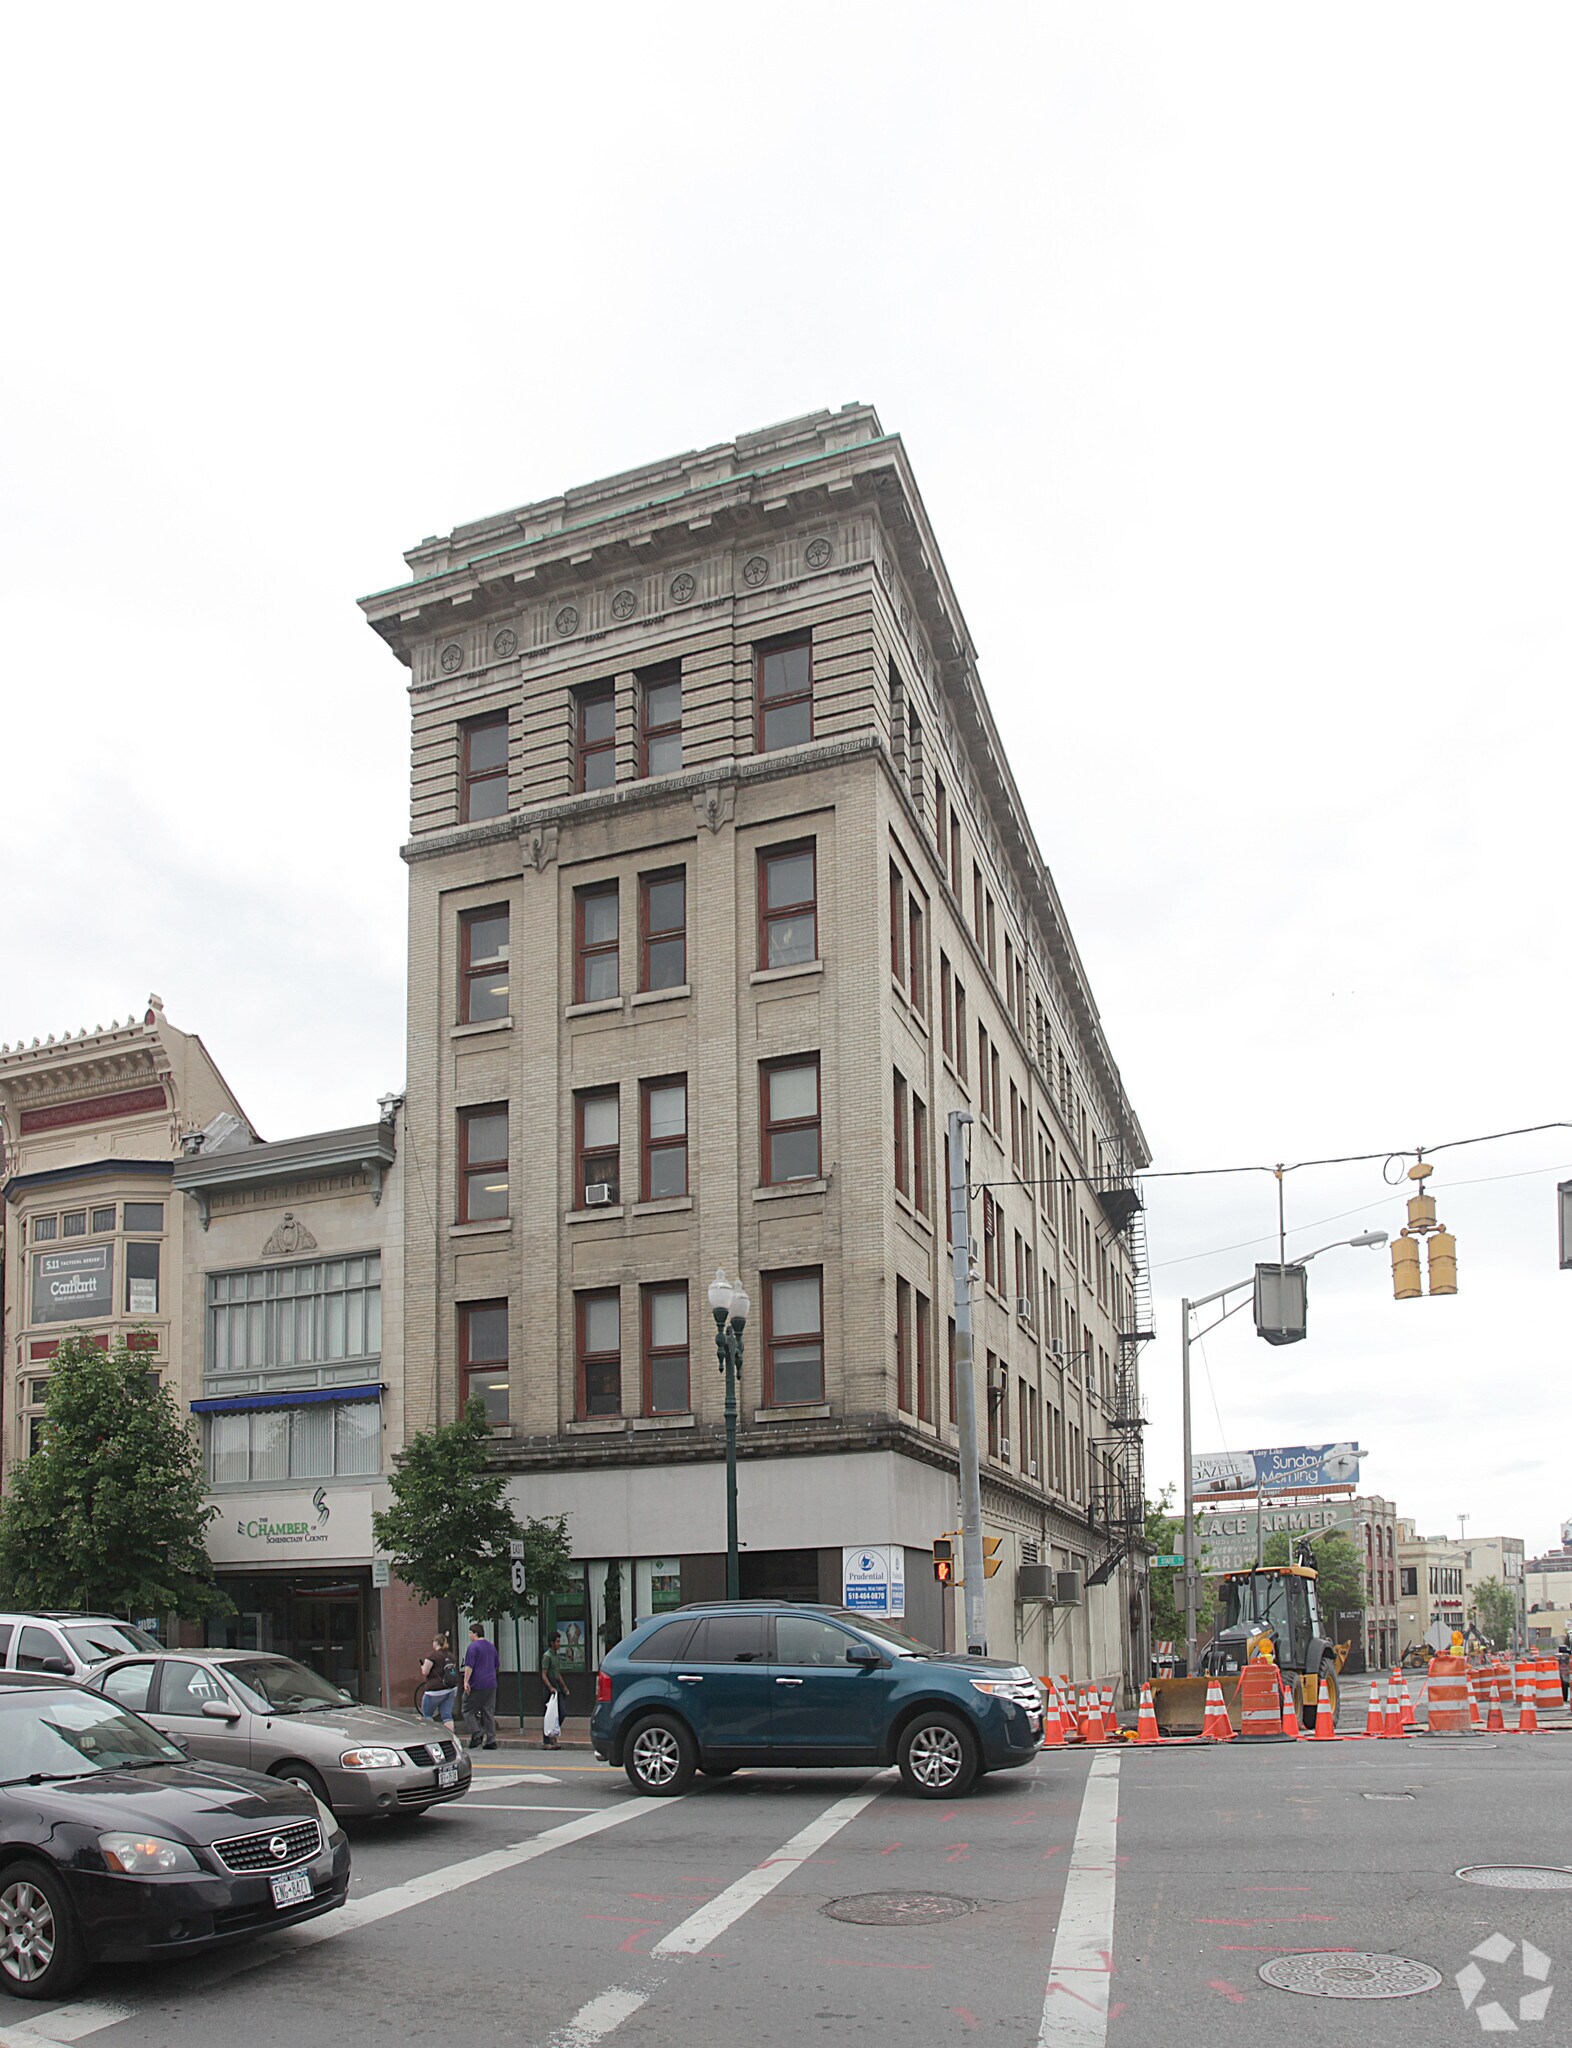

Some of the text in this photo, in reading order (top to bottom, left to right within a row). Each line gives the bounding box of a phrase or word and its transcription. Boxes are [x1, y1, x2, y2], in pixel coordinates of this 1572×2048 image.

[46, 1260, 59, 1270] 5.11
[51, 1277, 97, 1295] Carhartt
[1254, 1450, 1267, 1458] Easy
[1199, 1460, 1212, 1468] THE
[1273, 1453, 1321, 1469] Sunday
[1192, 1464, 1240, 1480] GAZETTE
[1261, 1470, 1318, 1485] Morning
[246, 1520, 309, 1538] CHAMBER
[304, 1534, 328, 1542] COUNTY
[512, 1543, 523, 1555] EAST
[516, 1568, 522, 1588] 5
[849, 1572, 884, 1580] Prudential
